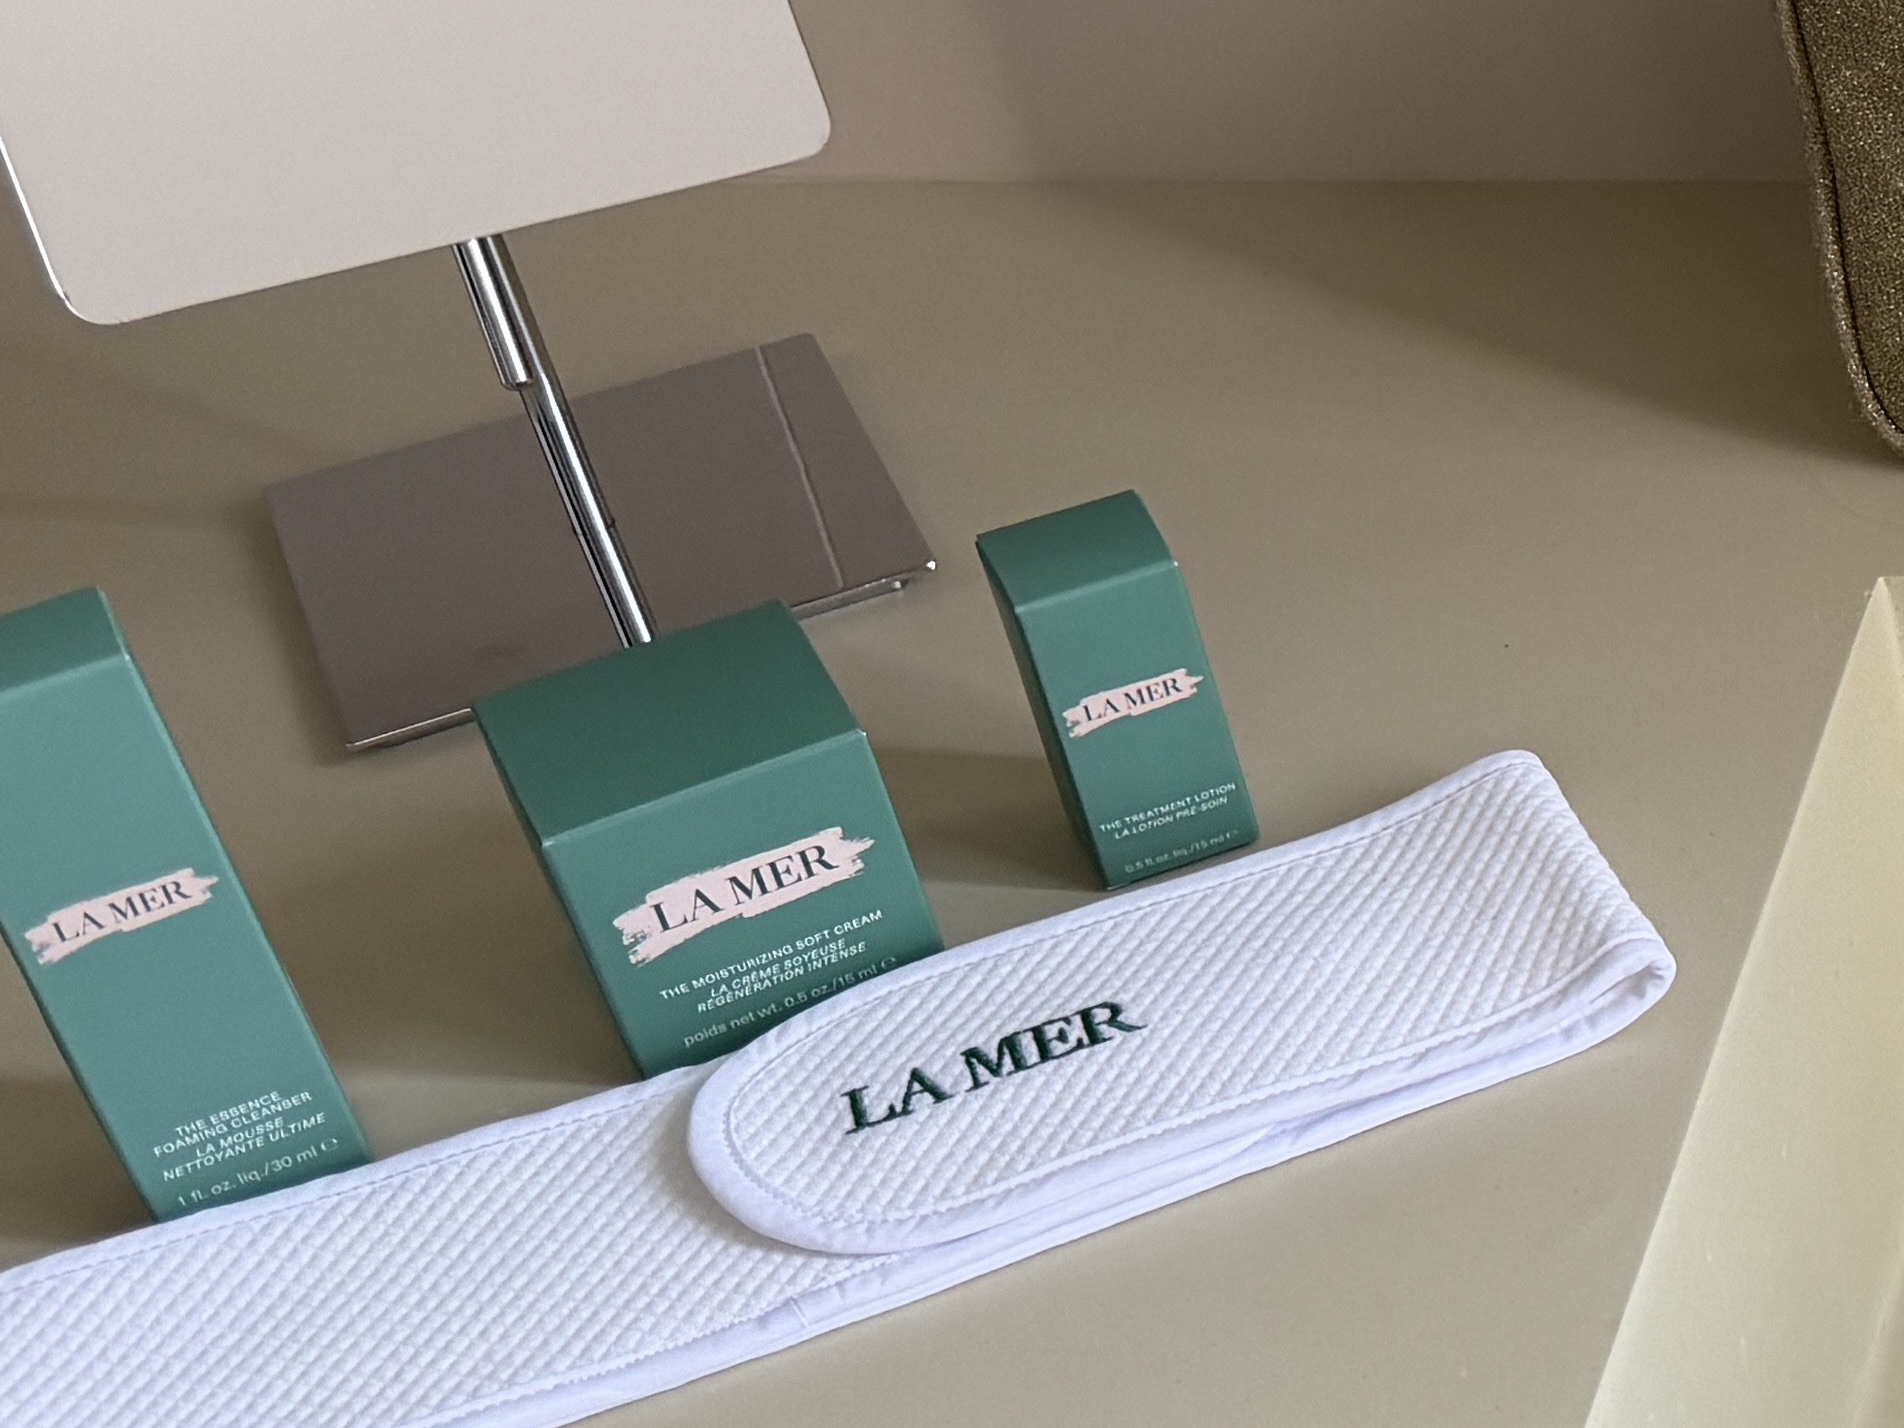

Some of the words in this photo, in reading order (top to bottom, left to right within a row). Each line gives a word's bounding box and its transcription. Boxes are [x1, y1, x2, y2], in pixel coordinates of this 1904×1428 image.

[1083, 698, 1120, 721] LA
[1123, 677, 1183, 710] MER
[1100, 819, 1122, 832] THE
[1124, 797, 1191, 824] TREATMENT
[1194, 782, 1236, 803] LOTION
[53, 911, 105, 943] LA
[108, 880, 193, 923] MER
[650, 888, 725, 933] LA
[725, 845, 839, 906] MER
[659, 983, 690, 1000] THE
[692, 945, 794, 990] MOISTURIZING
[796, 929, 831, 950] SOFT
[834, 909, 883, 936] CREAM
[710, 986, 729, 998] LA
[783, 938, 846, 972] SOYEUSE
[808, 942, 867, 972] INTENSE
[684, 1025, 728, 1049] poids
[731, 1012, 756, 1029] net
[756, 1002, 783, 1019] wt.
[840, 1067, 957, 1135] LA
[959, 1001, 1148, 1093] MER
[153, 1124, 228, 1158] FOAMING
[230, 1091, 313, 1129] CLEANSER
[175, 1119, 207, 1137] THE
[210, 1091, 283, 1125] ESSENCE
[196, 1143, 216, 1158] LA
[220, 1117, 285, 1149] MOUSSE
[163, 1135, 265, 1182] NETTOYANTE
[269, 1112, 327, 1143] ULTIME
[296, 1145, 318, 1163] ml
